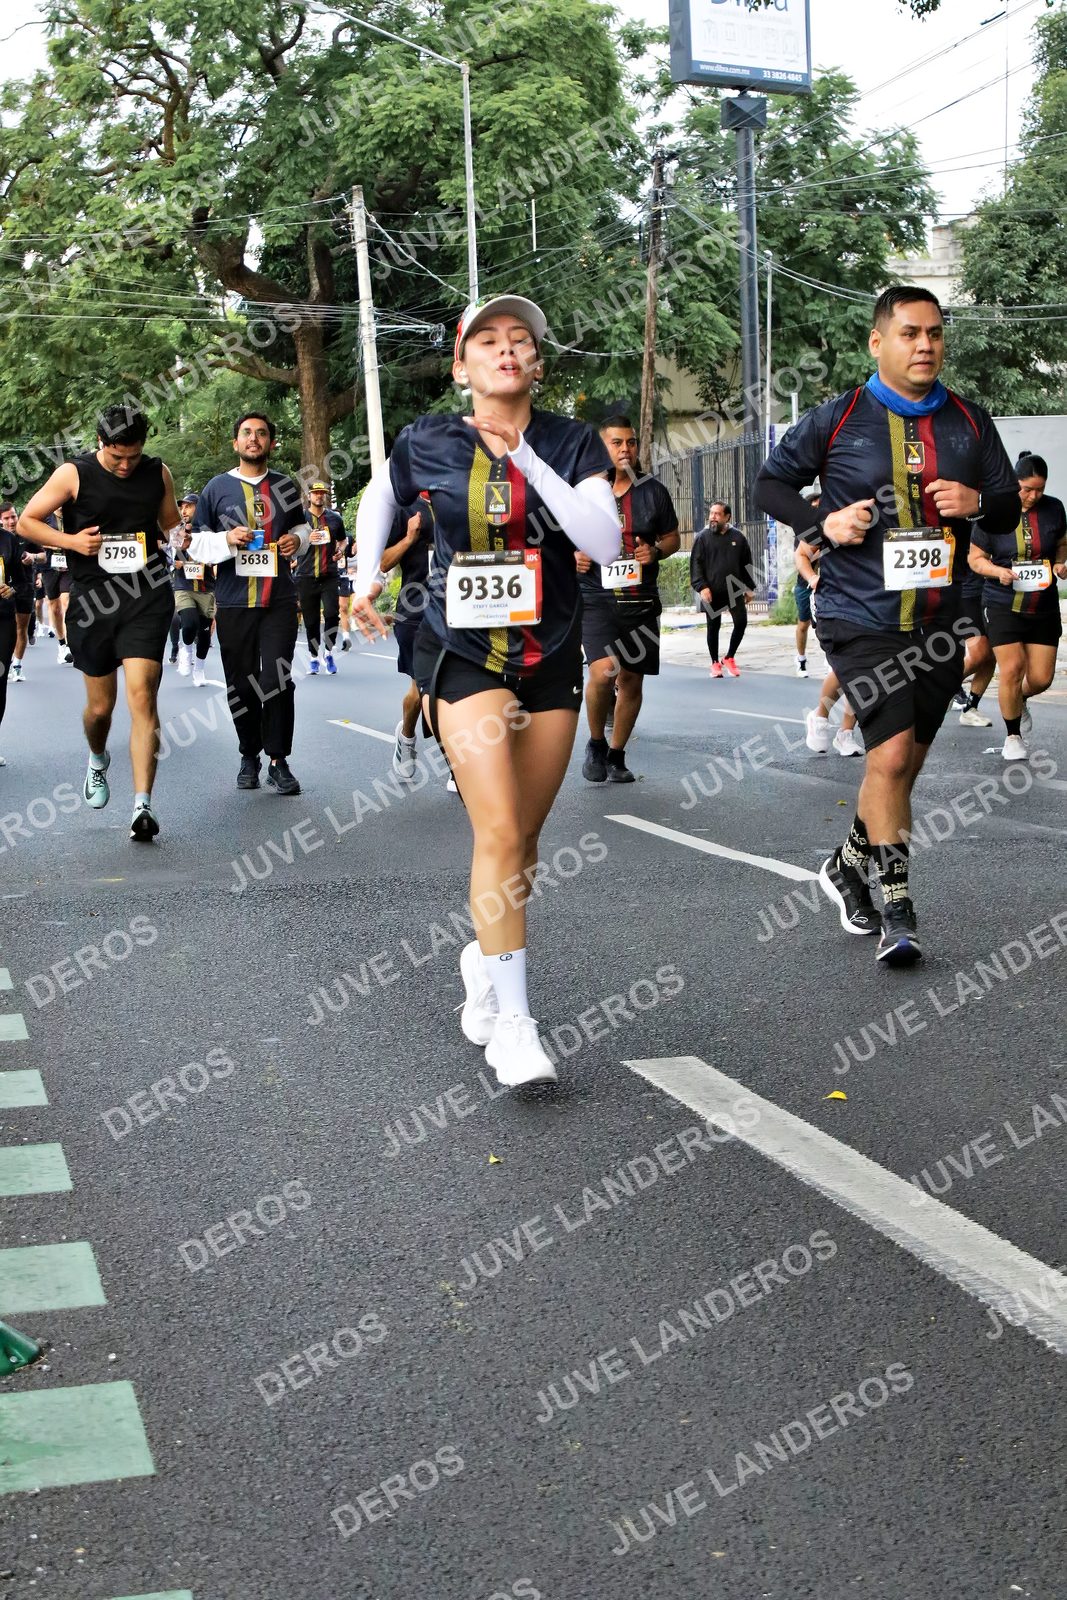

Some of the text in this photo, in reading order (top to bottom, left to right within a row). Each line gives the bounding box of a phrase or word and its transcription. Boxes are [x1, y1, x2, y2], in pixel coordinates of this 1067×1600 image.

[105, 547, 136, 560] 5798
[241, 554, 269, 565] 5638
[894, 548, 941, 568] 2398
[607, 564, 634, 576] 7175
[1018, 570, 1043, 580] 4295
[458, 575, 522, 600] 9336
